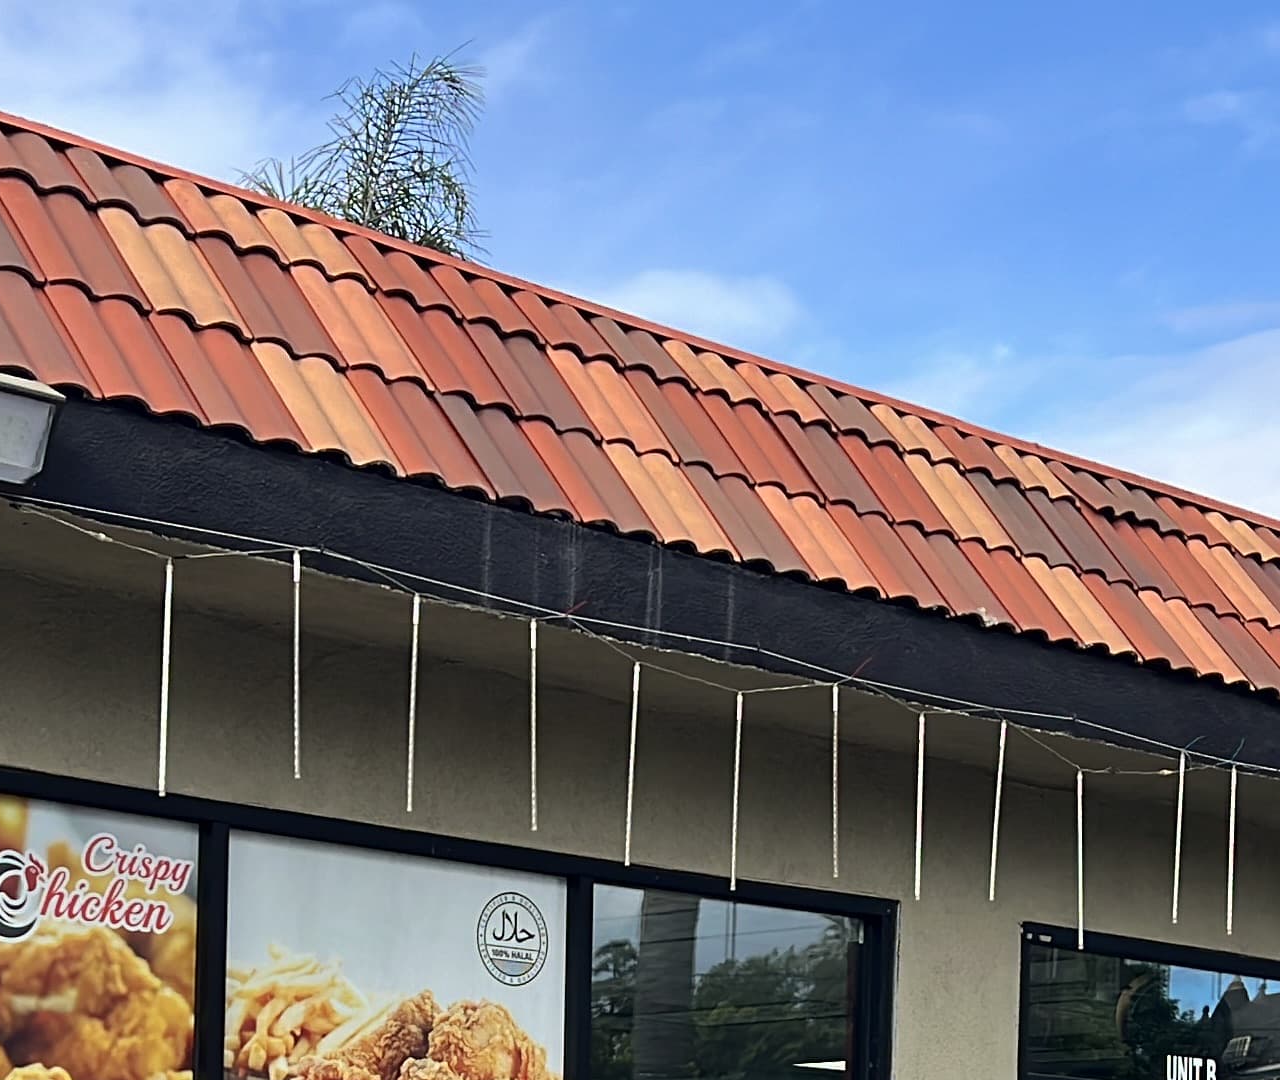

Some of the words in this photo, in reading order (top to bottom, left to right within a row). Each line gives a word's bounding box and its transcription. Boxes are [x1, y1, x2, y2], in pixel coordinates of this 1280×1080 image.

[84, 836, 191, 892] Crispy
[492, 909, 536, 943] حلال
[511, 951, 534, 961] HALAL
